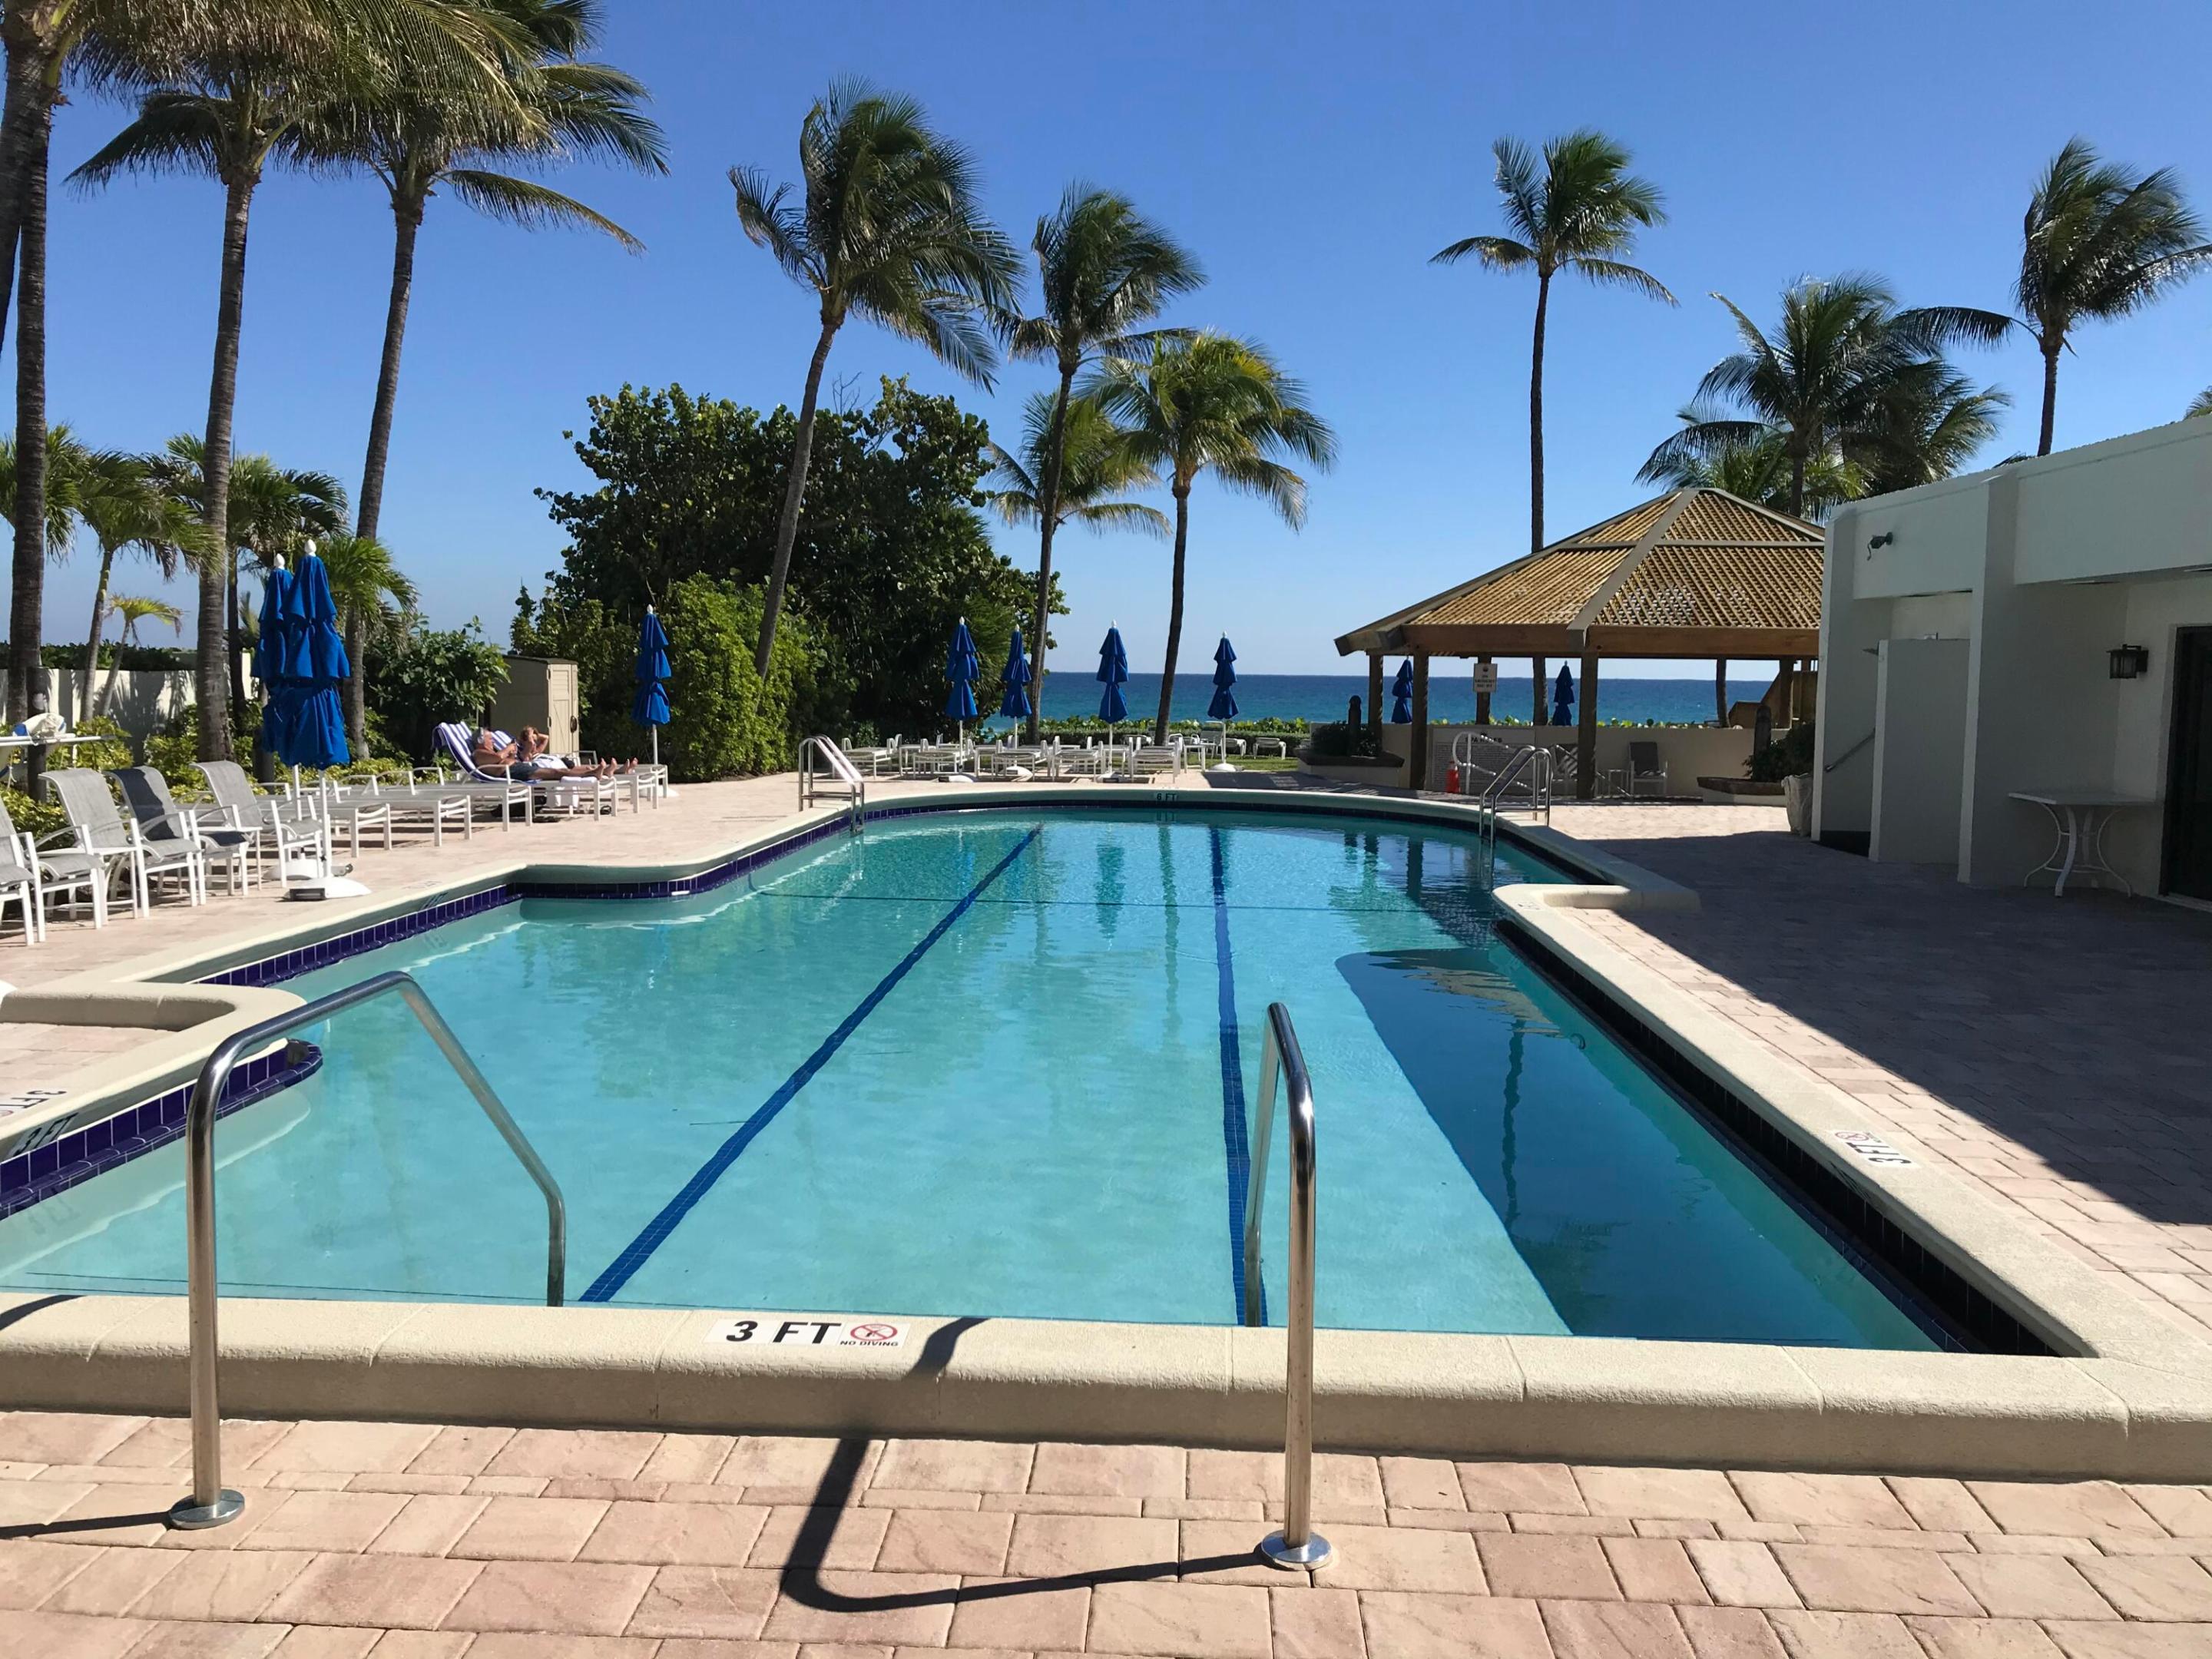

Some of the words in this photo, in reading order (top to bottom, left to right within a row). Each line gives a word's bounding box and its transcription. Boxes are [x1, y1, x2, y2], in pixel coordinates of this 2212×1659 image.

[1165, 793, 1177, 801] FT
[13, 1128, 42, 1157] 3
[34, 1112, 79, 1148] FT
[1846, 1142, 1899, 1155] FT
[726, 1320, 758, 1342] 3
[773, 1322, 842, 1344] FT
